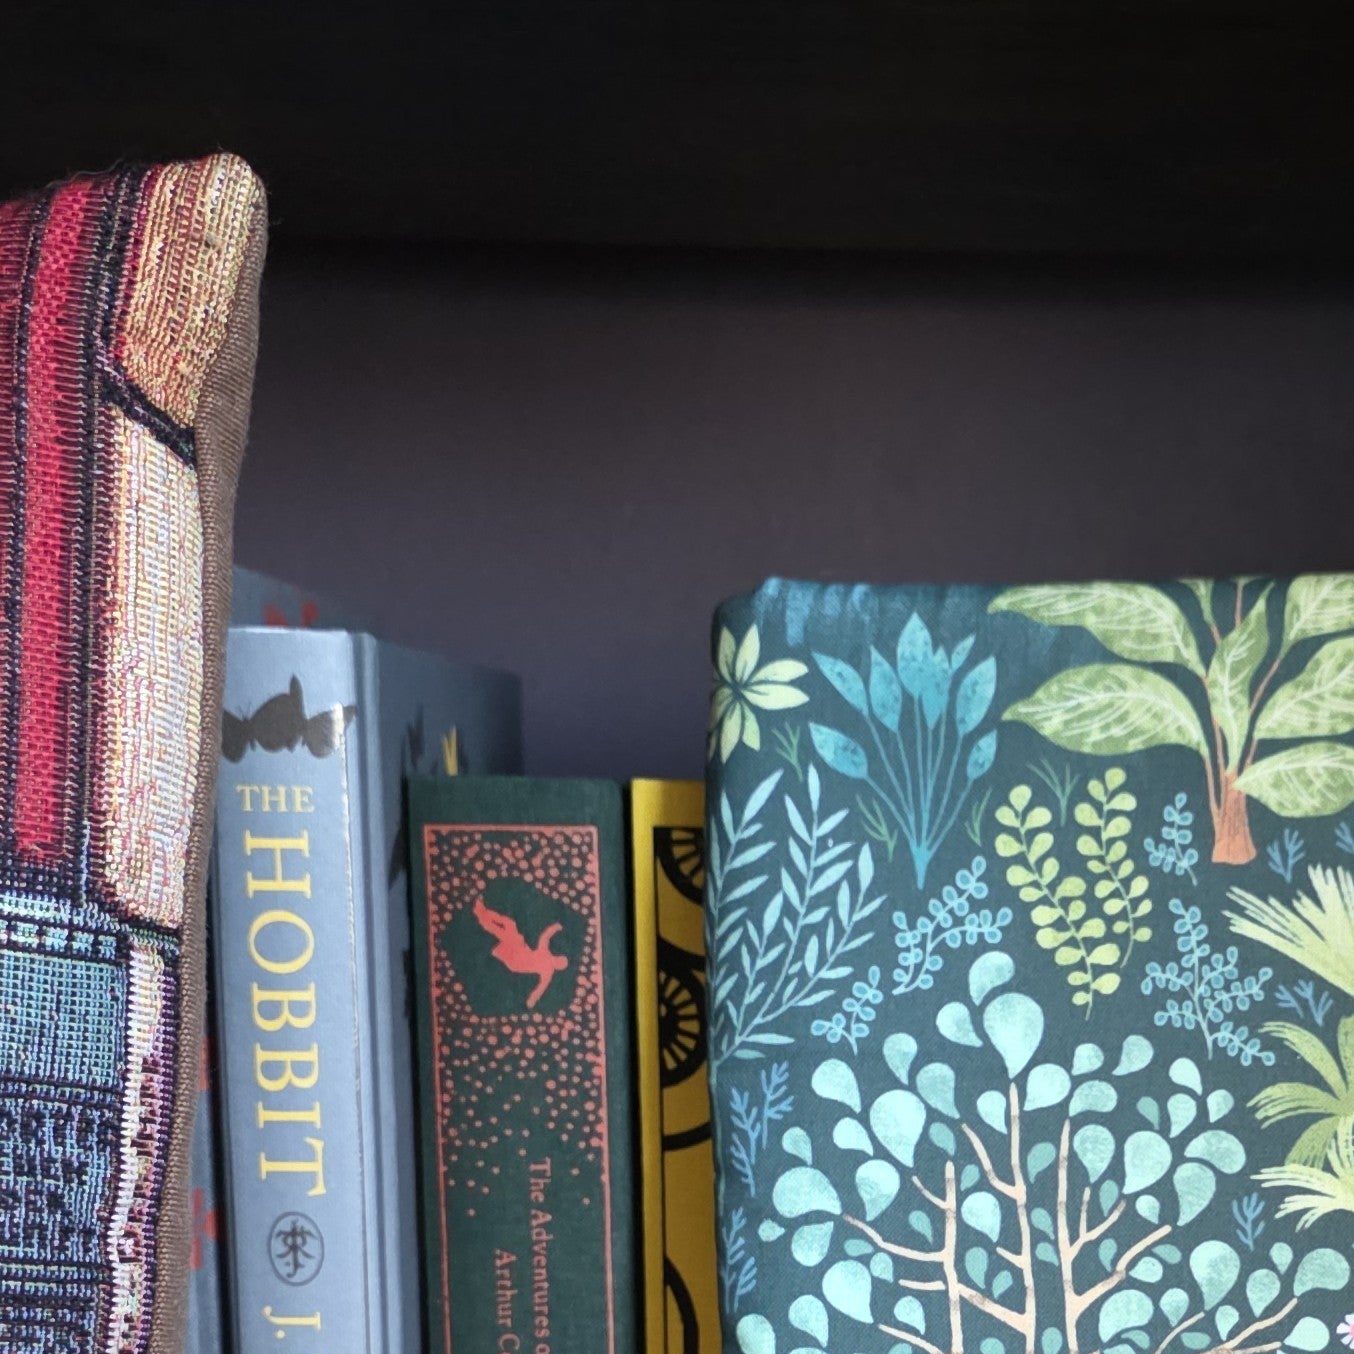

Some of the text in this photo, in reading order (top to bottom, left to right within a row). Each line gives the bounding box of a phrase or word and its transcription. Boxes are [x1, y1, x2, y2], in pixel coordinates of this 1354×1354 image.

[235, 783, 316, 813] THE
[244, 830, 327, 1197] HOBBIT
[529, 1156, 552, 1203] The
[494, 1248, 518, 1328] Arthur
[530, 1208, 554, 1338] Adventures
